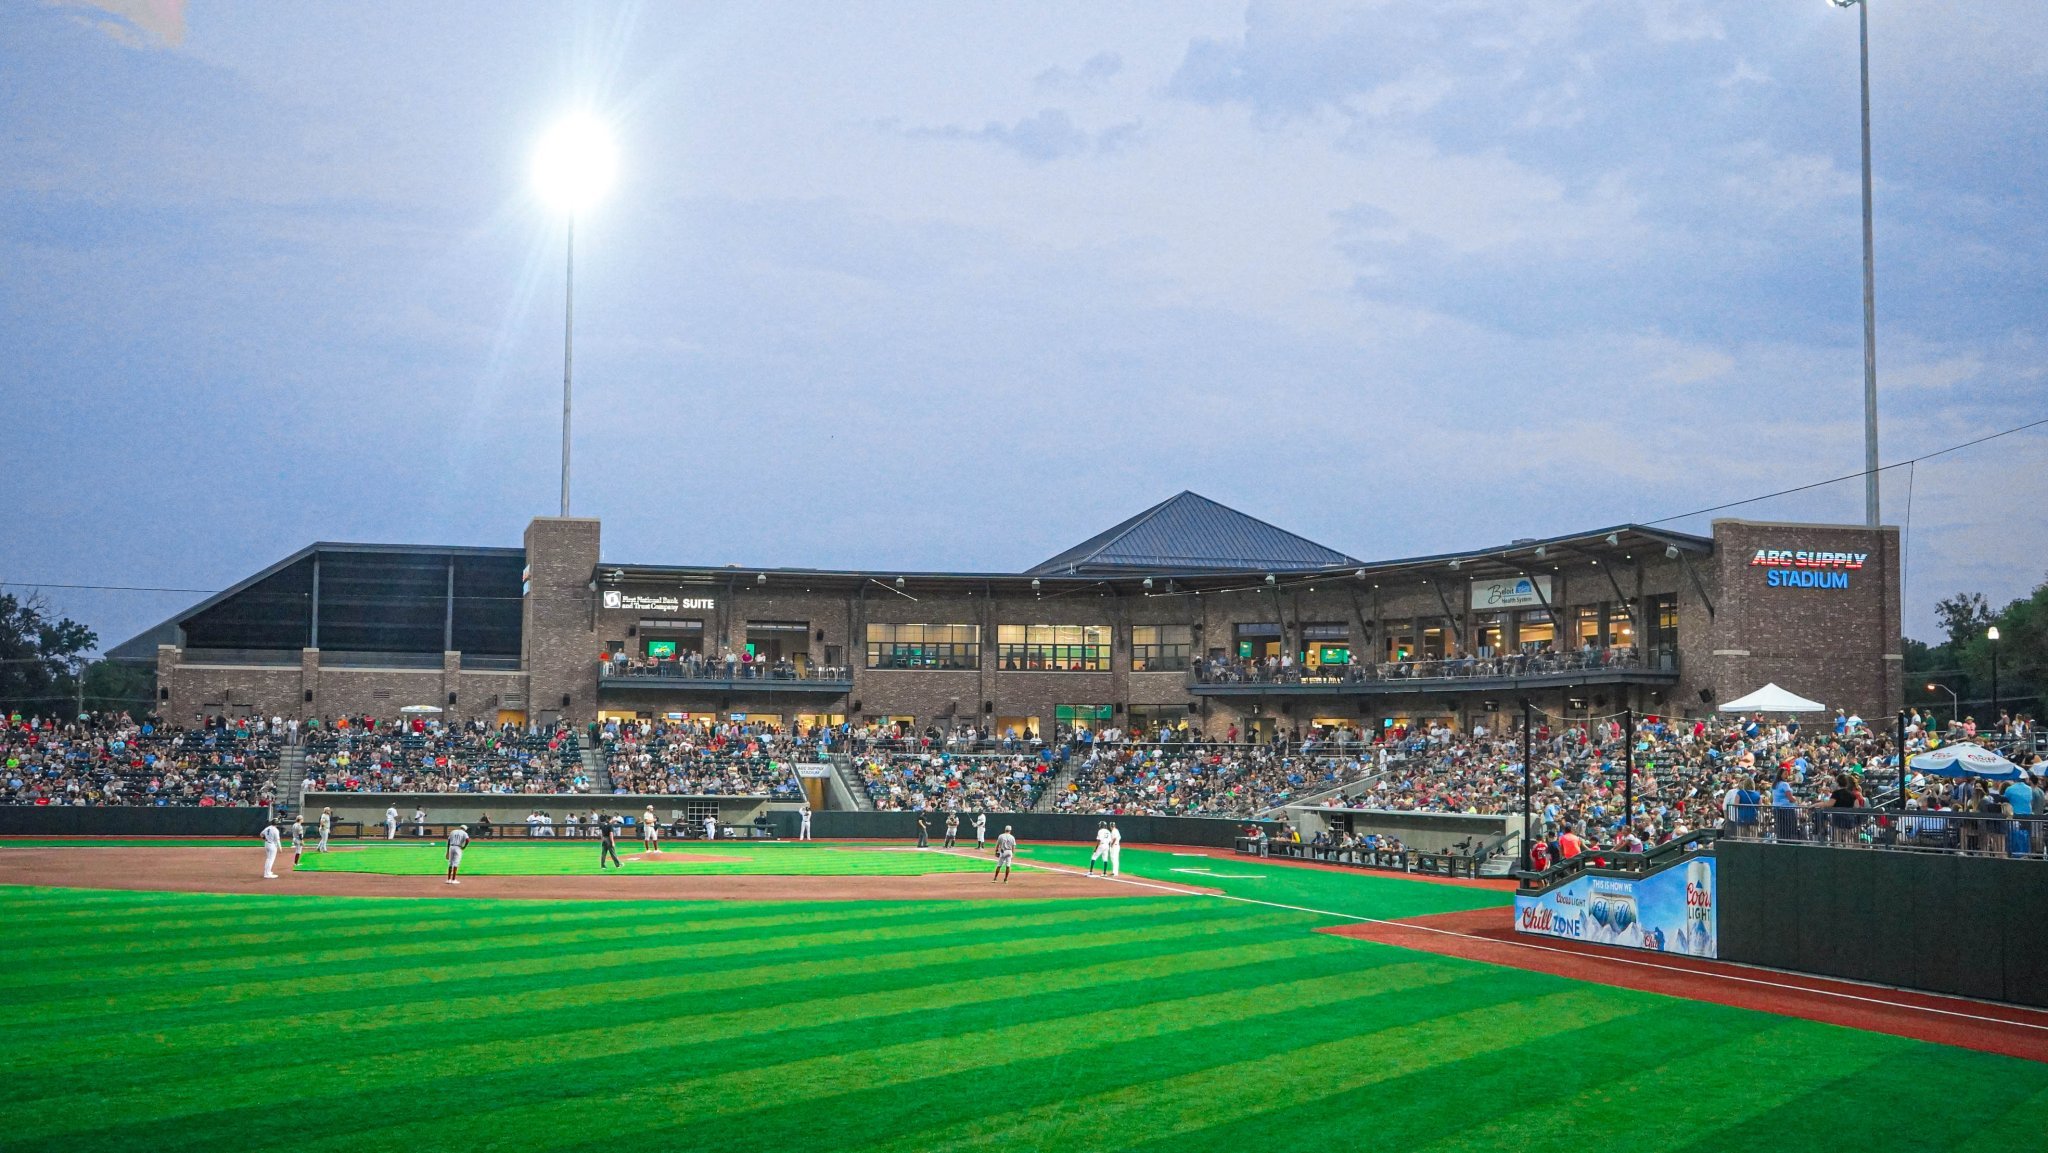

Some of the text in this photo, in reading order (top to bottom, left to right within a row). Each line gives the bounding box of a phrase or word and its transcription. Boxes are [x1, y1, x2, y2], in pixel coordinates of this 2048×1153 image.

[1750, 549, 1867, 569] ABC SUPPLY
[1767, 570, 1848, 589] STADIUM
[637, 596, 662, 604] National
[1488, 584, 1514, 604] Beloit
[651, 604, 679, 612] Company
[683, 599, 714, 609] SUITE
[1593, 880, 1632, 892] THIS IS HOW WE
[1571, 898, 1586, 907] LIGHT
[1688, 908, 1711, 920] LIGHT
[1522, 906, 1580, 936] Chill ZONE
